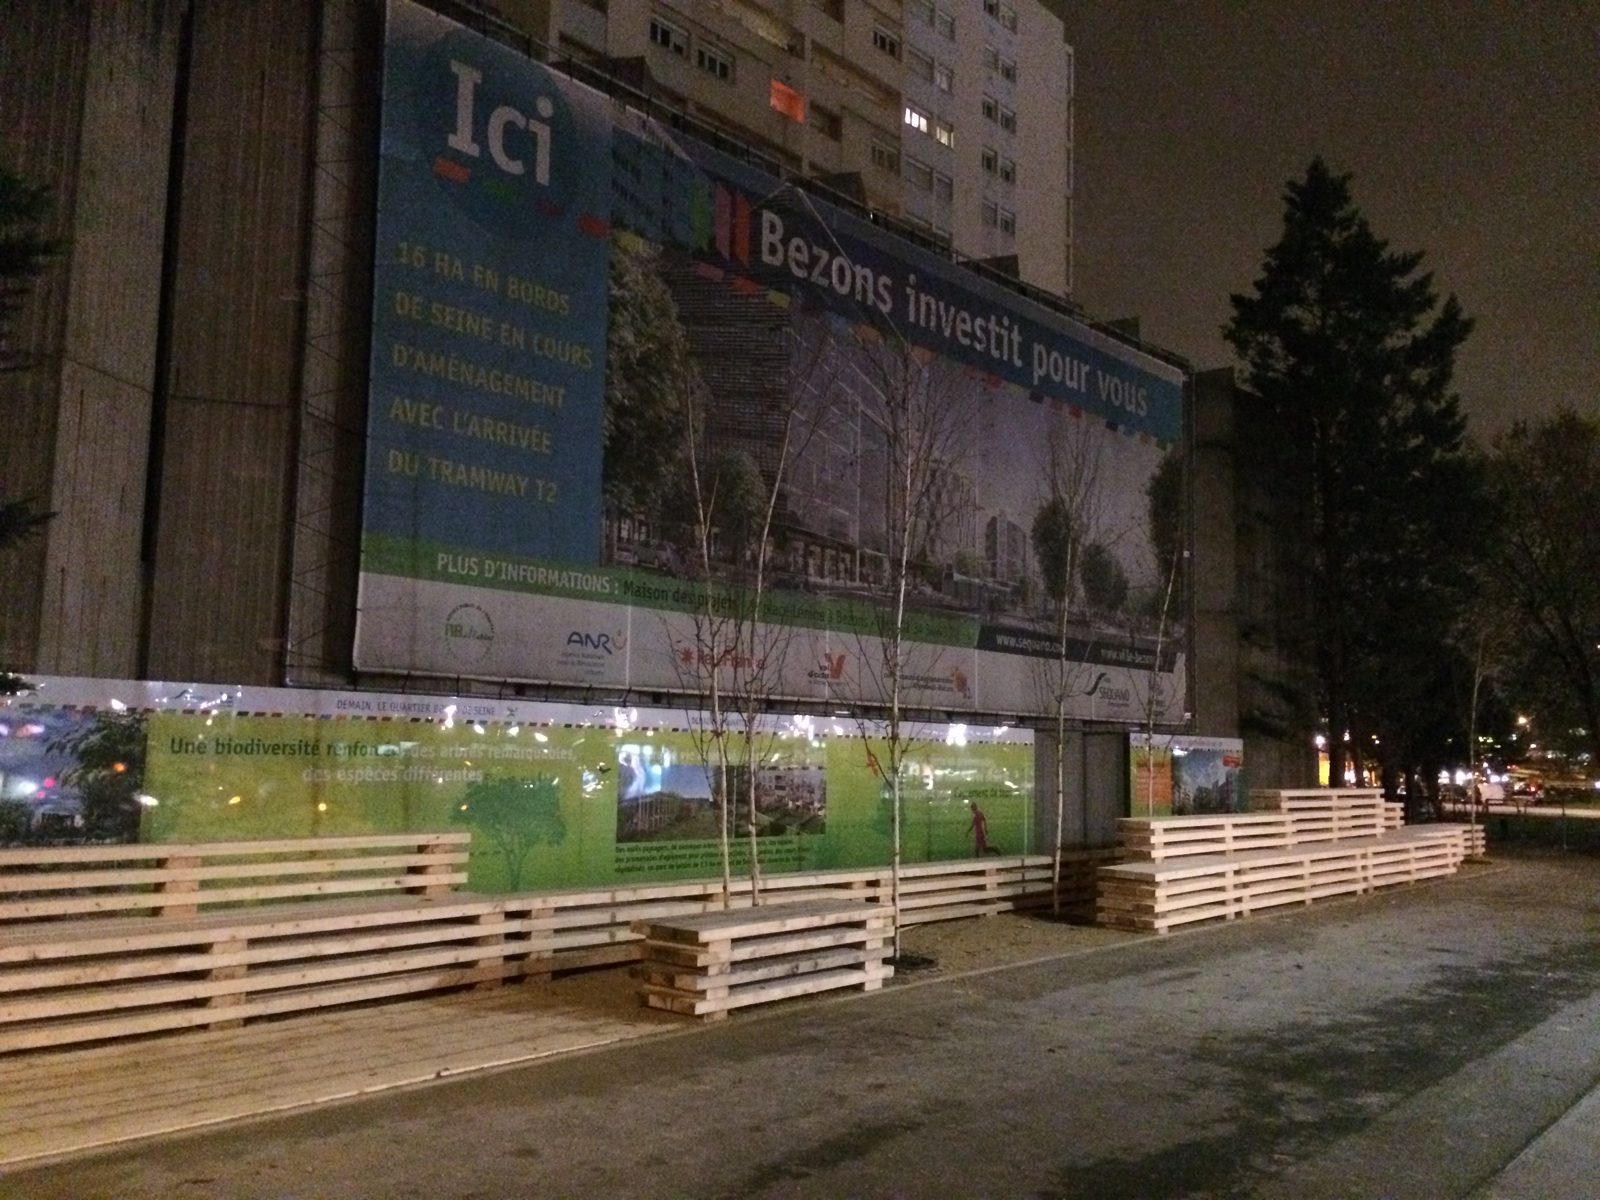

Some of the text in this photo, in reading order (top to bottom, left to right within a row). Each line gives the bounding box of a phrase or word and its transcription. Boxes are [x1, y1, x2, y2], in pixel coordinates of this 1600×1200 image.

[448, 59, 553, 186] Ici
[398, 241, 570, 316] 16 HA EN BORDS
[394, 291, 593, 369] DE SEINE EN COURS
[761, 208, 1148, 417] Bezons investit pour vous
[392, 344, 566, 408] D'AMÉNAGEMENT
[389, 397, 553, 455] AVEC L'ARRIVÉE
[388, 448, 558, 504] DU TRAMWAY T2
[436, 552, 479, 577] PLUS
[484, 561, 610, 594] D'INFORMATIONS
[623, 580, 669, 602] Maison
[672, 587, 695, 605] des
[377, 701, 388, 712] LE
[390, 701, 431, 714] QUARTIER
[473, 705, 496, 716] SEINE
[169, 737, 207, 755] Une
[214, 736, 320, 757] biodiversité
[440, 743, 485, 759] arbres
[302, 763, 484, 785] des espèces différentes
